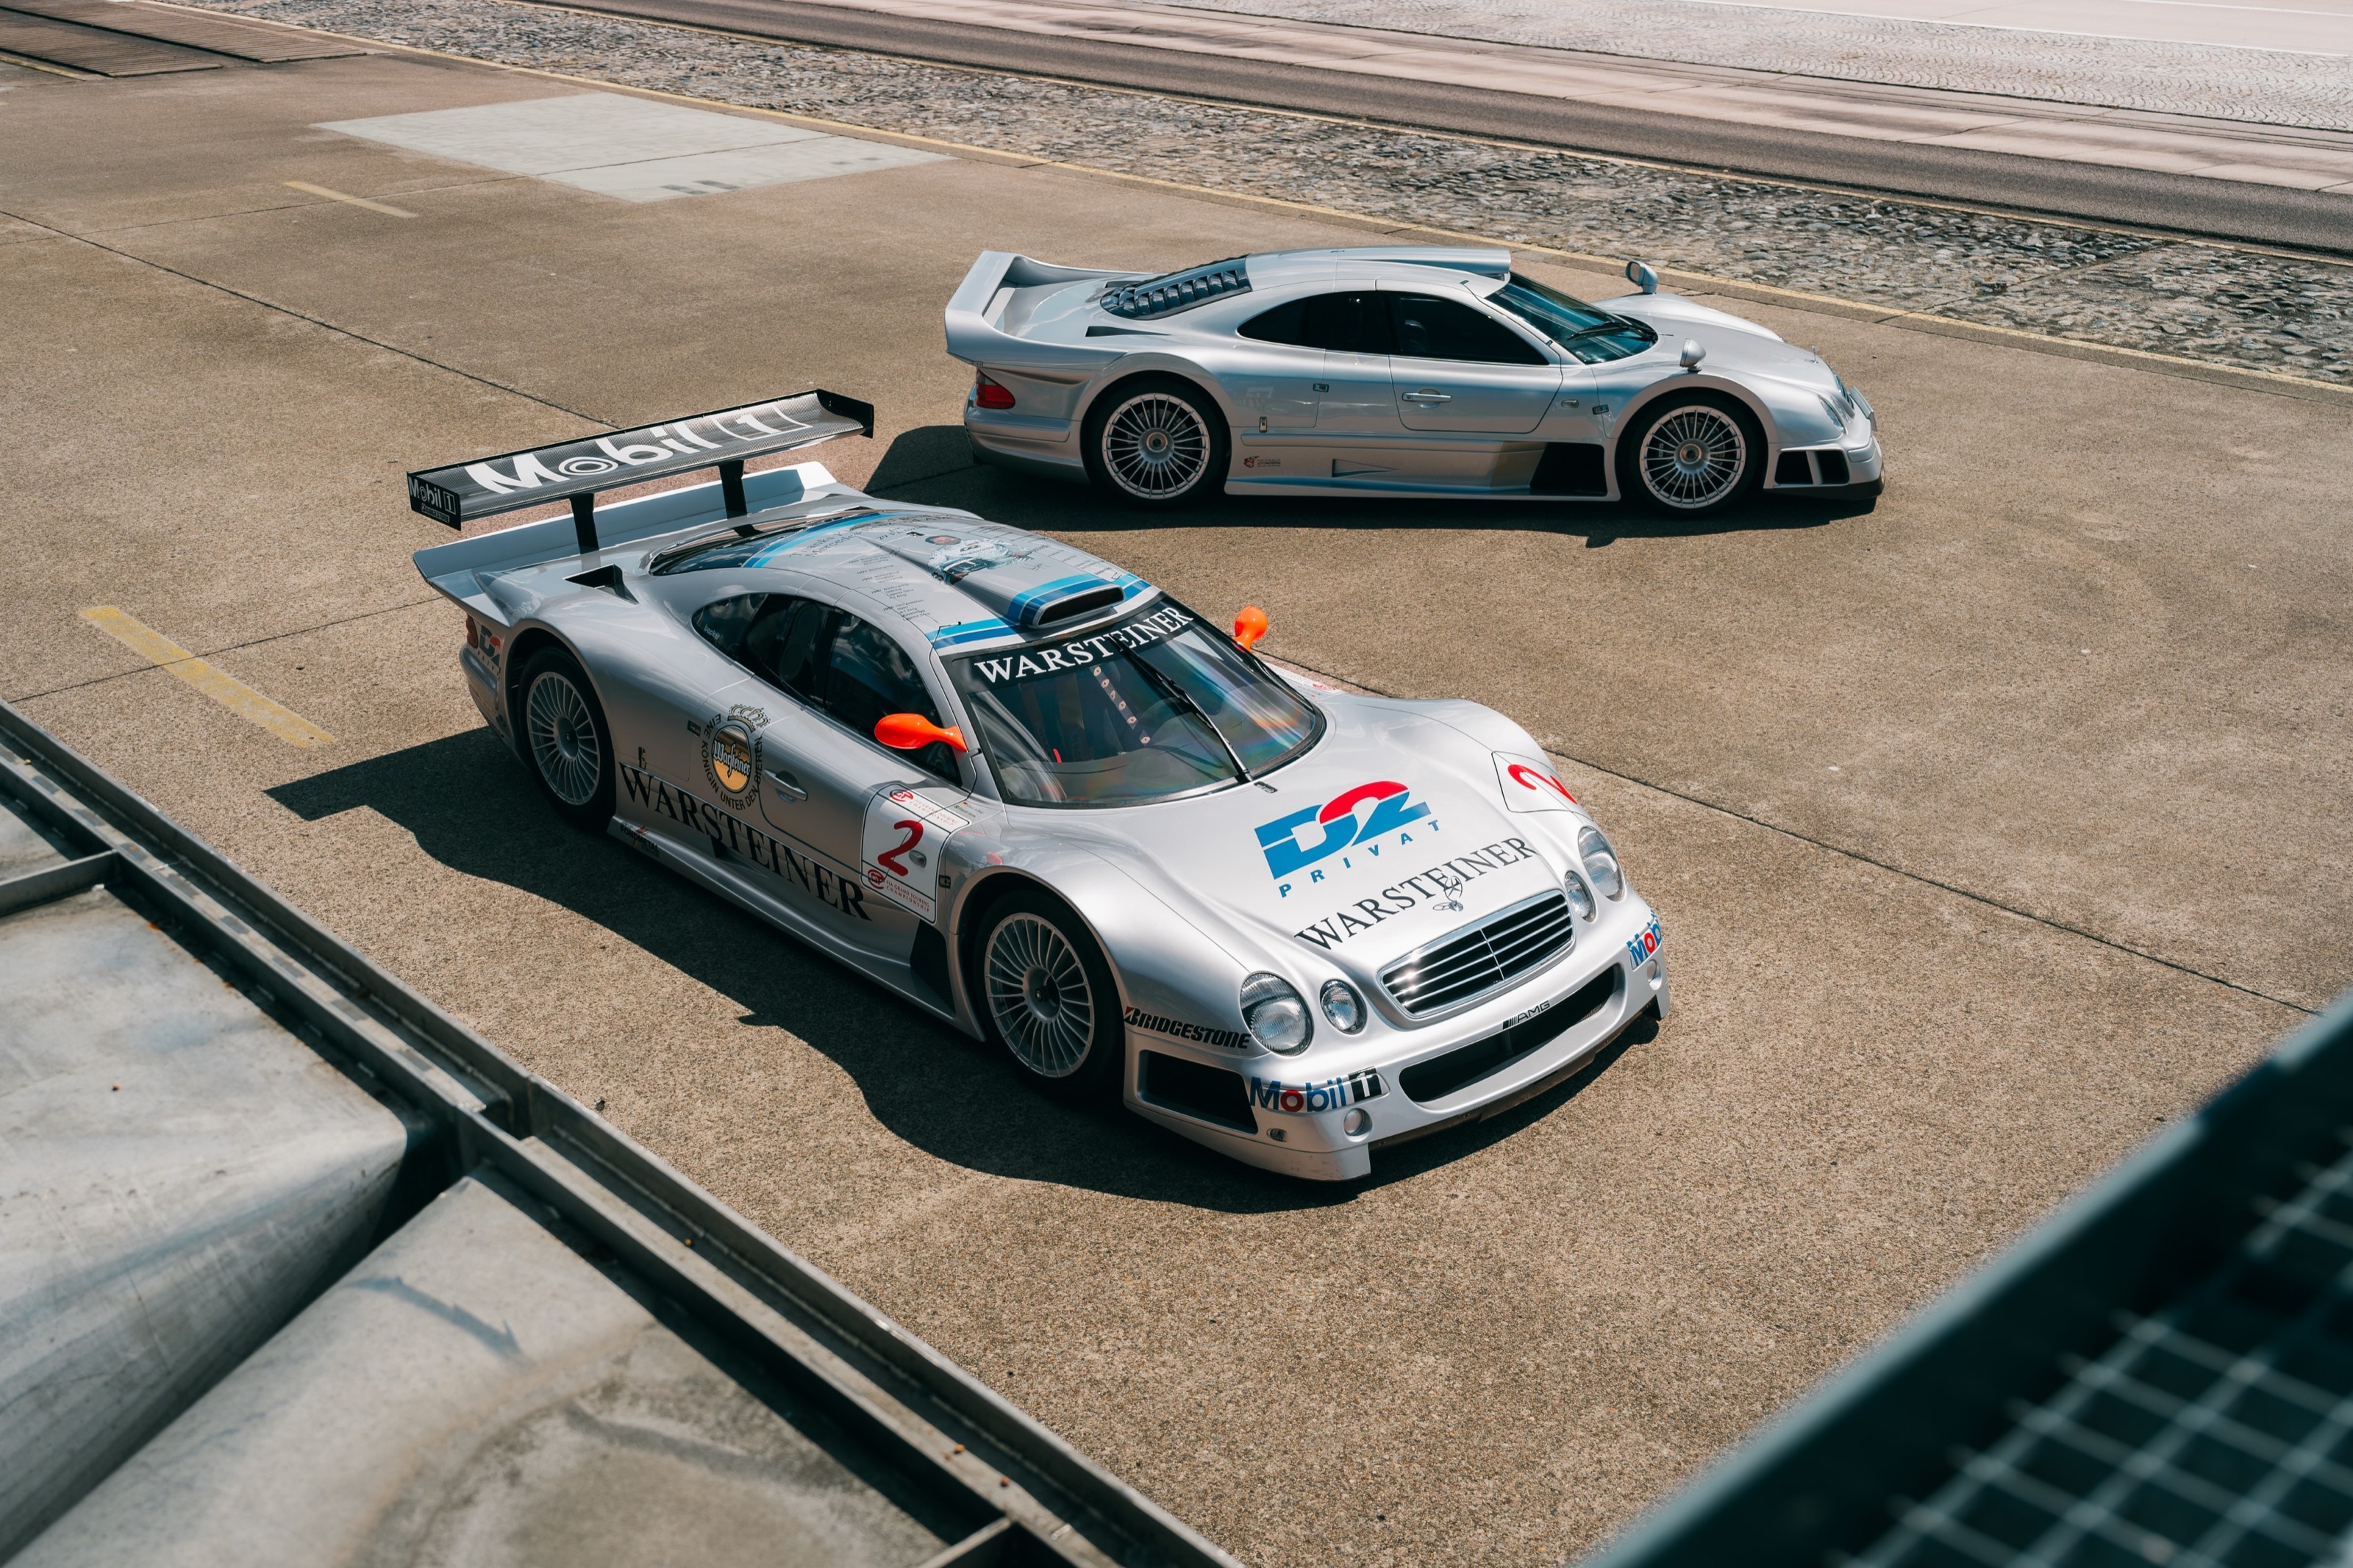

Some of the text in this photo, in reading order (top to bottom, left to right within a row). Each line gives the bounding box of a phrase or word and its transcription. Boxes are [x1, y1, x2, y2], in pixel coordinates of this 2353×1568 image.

[465, 422, 722, 495] Mobil
[408, 476, 442, 509] Mobil
[974, 607, 1194, 683] WARSTEINER
[704, 713, 721, 739] EINE
[701, 740, 719, 794] KÖNIGIN
[1508, 764, 1578, 804] 2
[720, 791, 746, 811] UNTER
[745, 786, 758, 807] DEN
[618, 762, 873, 921] WARSTEINER
[877, 820, 924, 877] 2
[1254, 781, 1432, 881] D2
[1279, 819, 1440, 898] PRIVAT
[886, 886, 930, 912] CHAMPIONSHIP
[894, 884, 910, 896] GRAND
[910, 893, 929, 907] TOURING
[1294, 837, 1540, 951] WARSTEINER
[1627, 910, 1662, 967] Mob
[1124, 1006, 1252, 1050] BRIDGESTONE
[1517, 1000, 1551, 1023] AMG
[1250, 1076, 1347, 1113] Mobil
